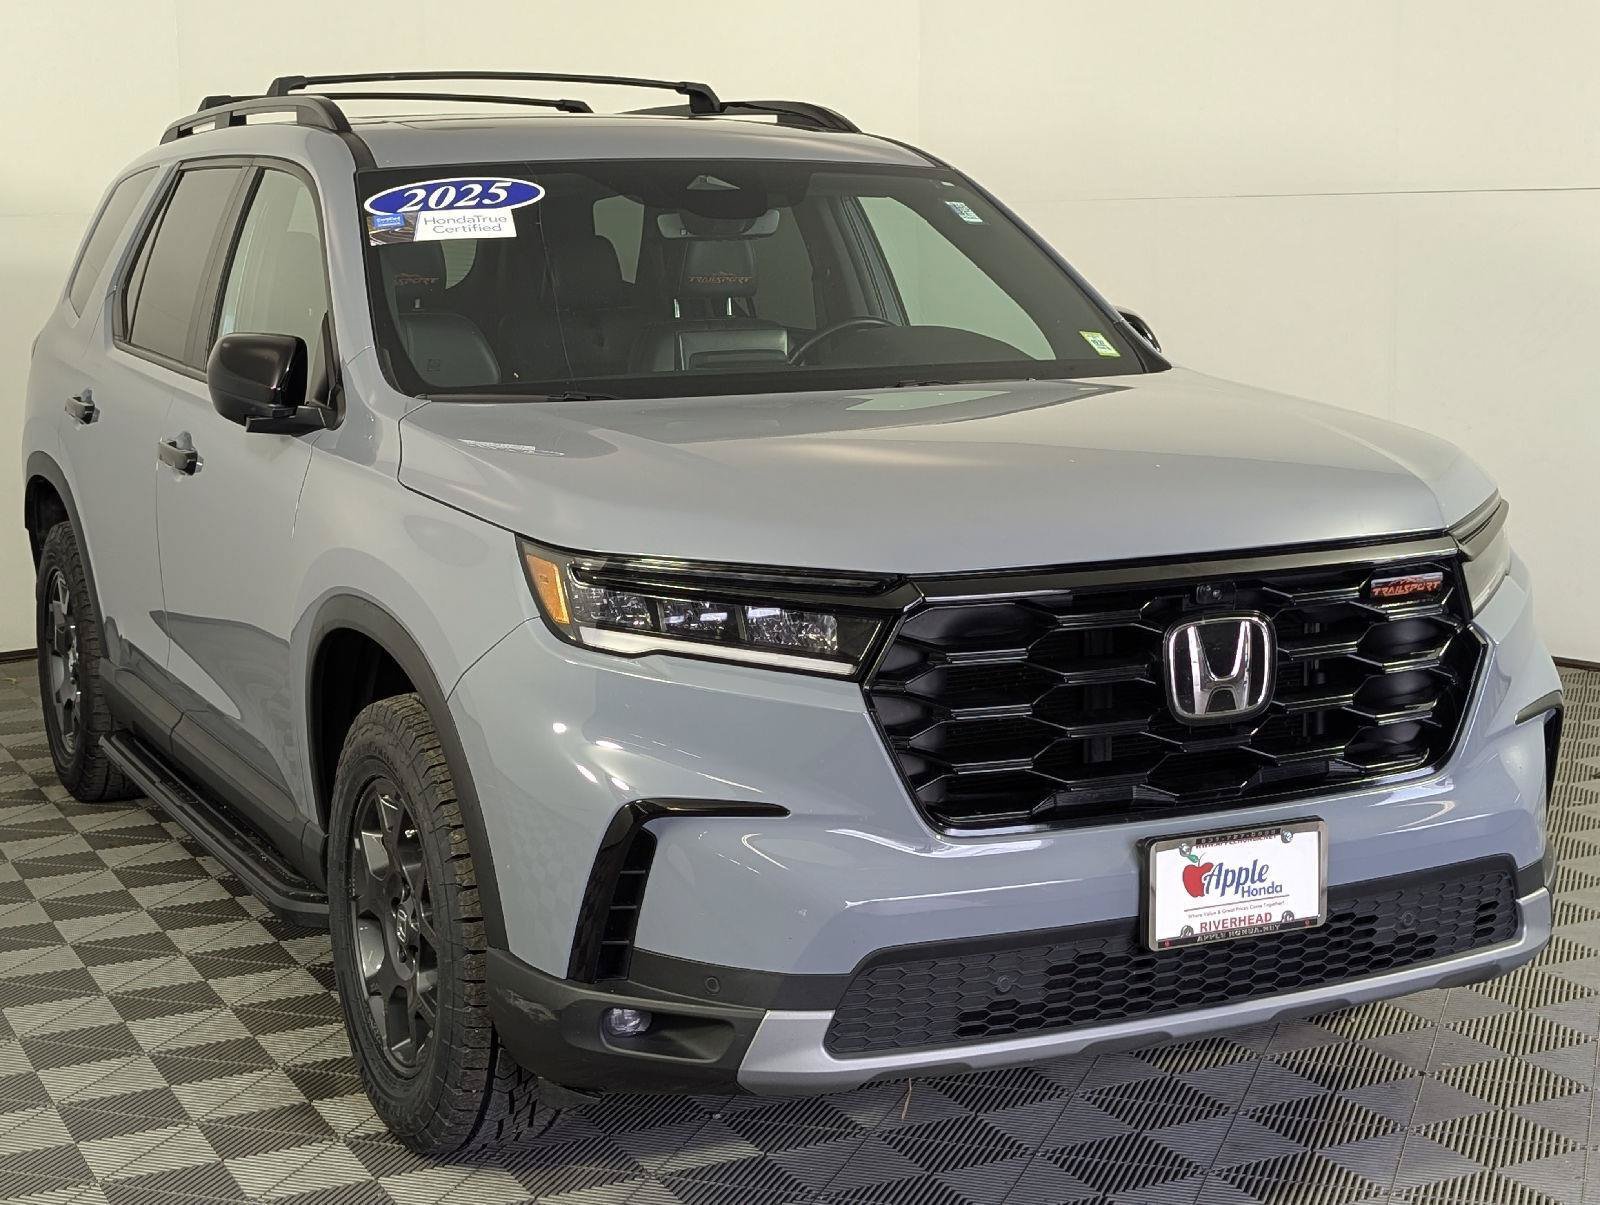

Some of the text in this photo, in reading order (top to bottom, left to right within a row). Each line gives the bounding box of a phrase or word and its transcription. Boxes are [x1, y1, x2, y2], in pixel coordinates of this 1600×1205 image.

[397, 181, 513, 213] 2025
[424, 214, 508, 225] HondaTrue
[432, 223, 502, 234] Certified
[1372, 581, 1440, 597] TRAILSPORT
[1203, 859, 1269, 897] Apple
[1241, 881, 1283, 898] Honda
[1200, 912, 1272, 933] RIVERHEAD
